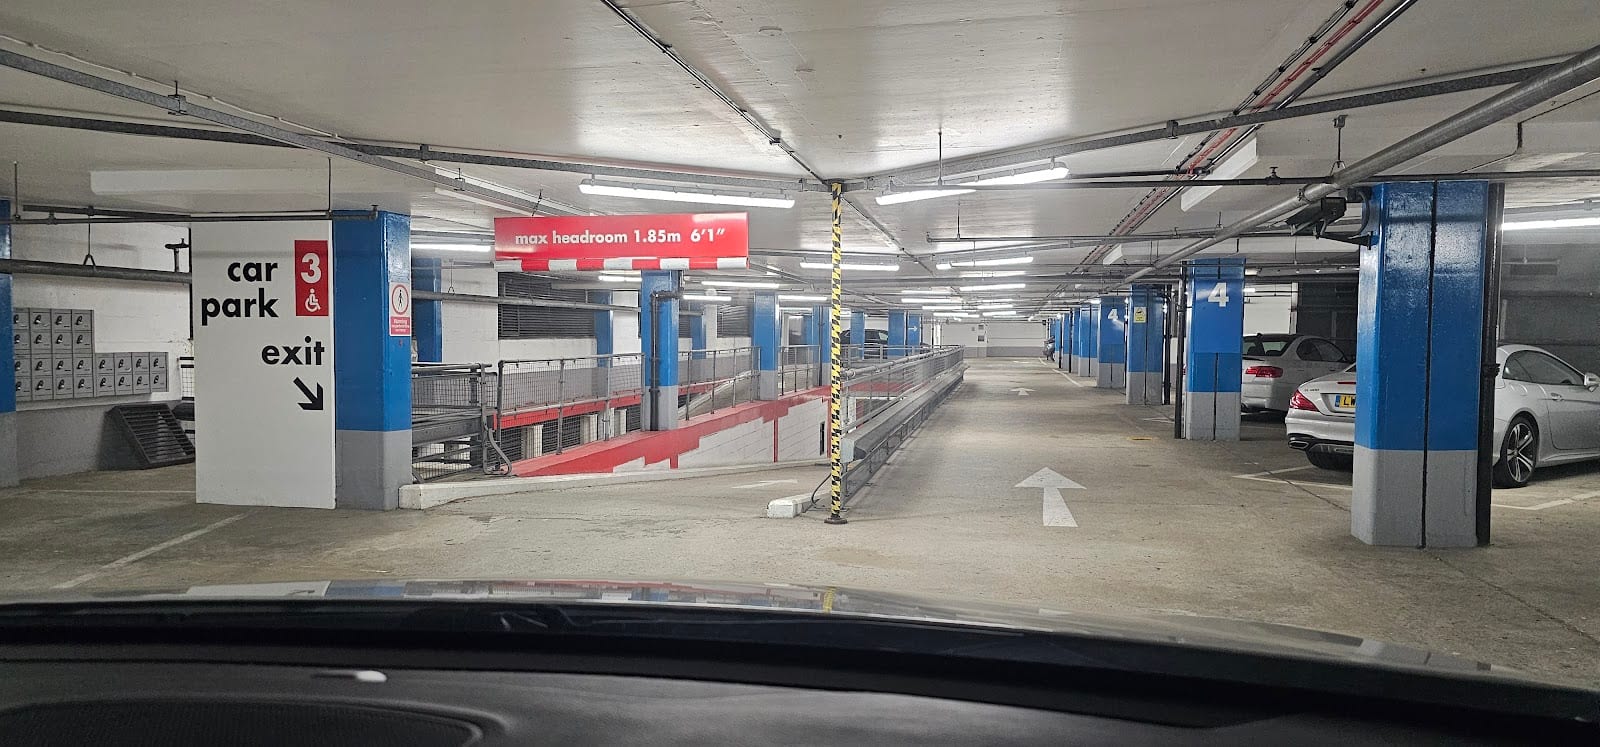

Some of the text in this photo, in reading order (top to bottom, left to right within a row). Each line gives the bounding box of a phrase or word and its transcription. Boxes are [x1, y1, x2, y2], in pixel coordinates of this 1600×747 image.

[515, 234, 548, 245] max
[552, 230, 628, 244] headroom
[634, 229, 681, 243] 1.85m
[228, 262, 278, 282] car
[301, 253, 322, 284] 3
[201, 288, 279, 326] park
[1207, 282, 1230, 308] 4
[1107, 308, 1119, 320] 4
[261, 336, 325, 366] exit
